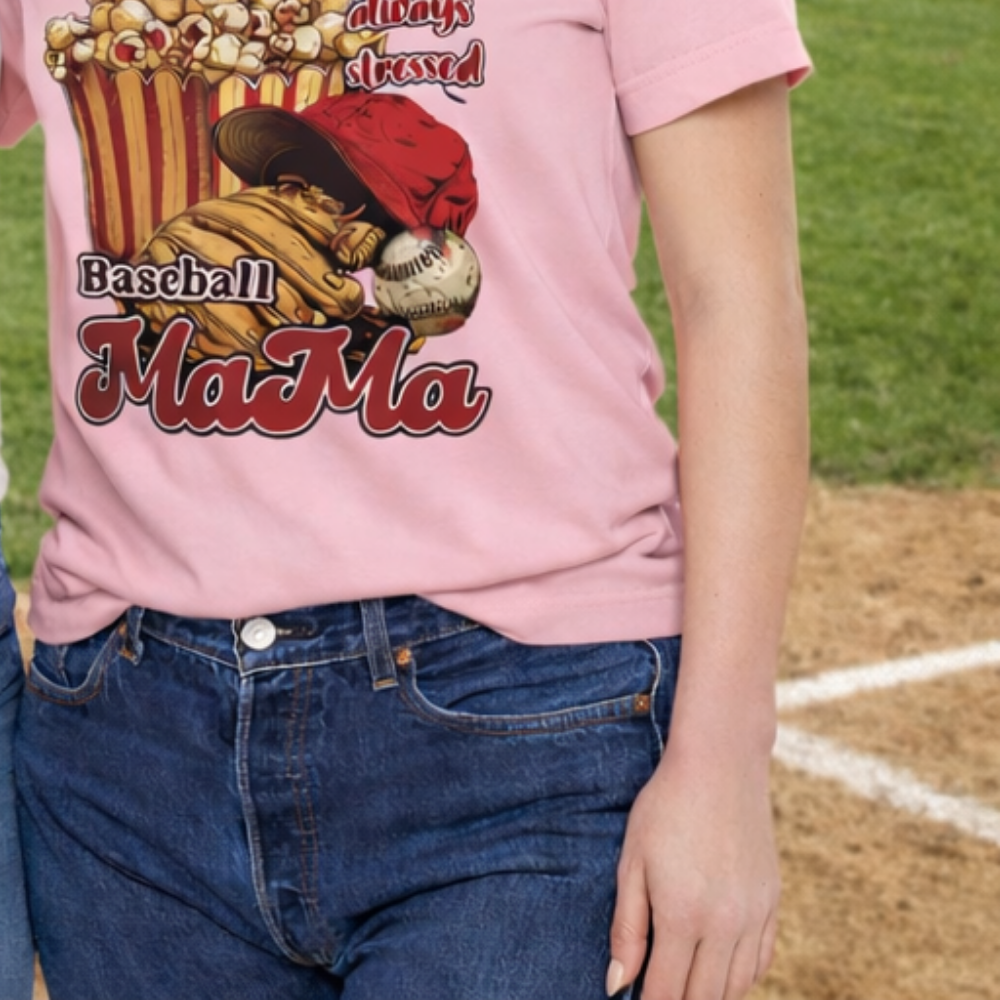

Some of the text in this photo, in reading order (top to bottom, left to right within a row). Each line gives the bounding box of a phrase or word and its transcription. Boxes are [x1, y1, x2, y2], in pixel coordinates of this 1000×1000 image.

[345, 40, 485, 90] stressed
[77, 251, 278, 304] Baseball
[76, 313, 493, 439] MaMa
